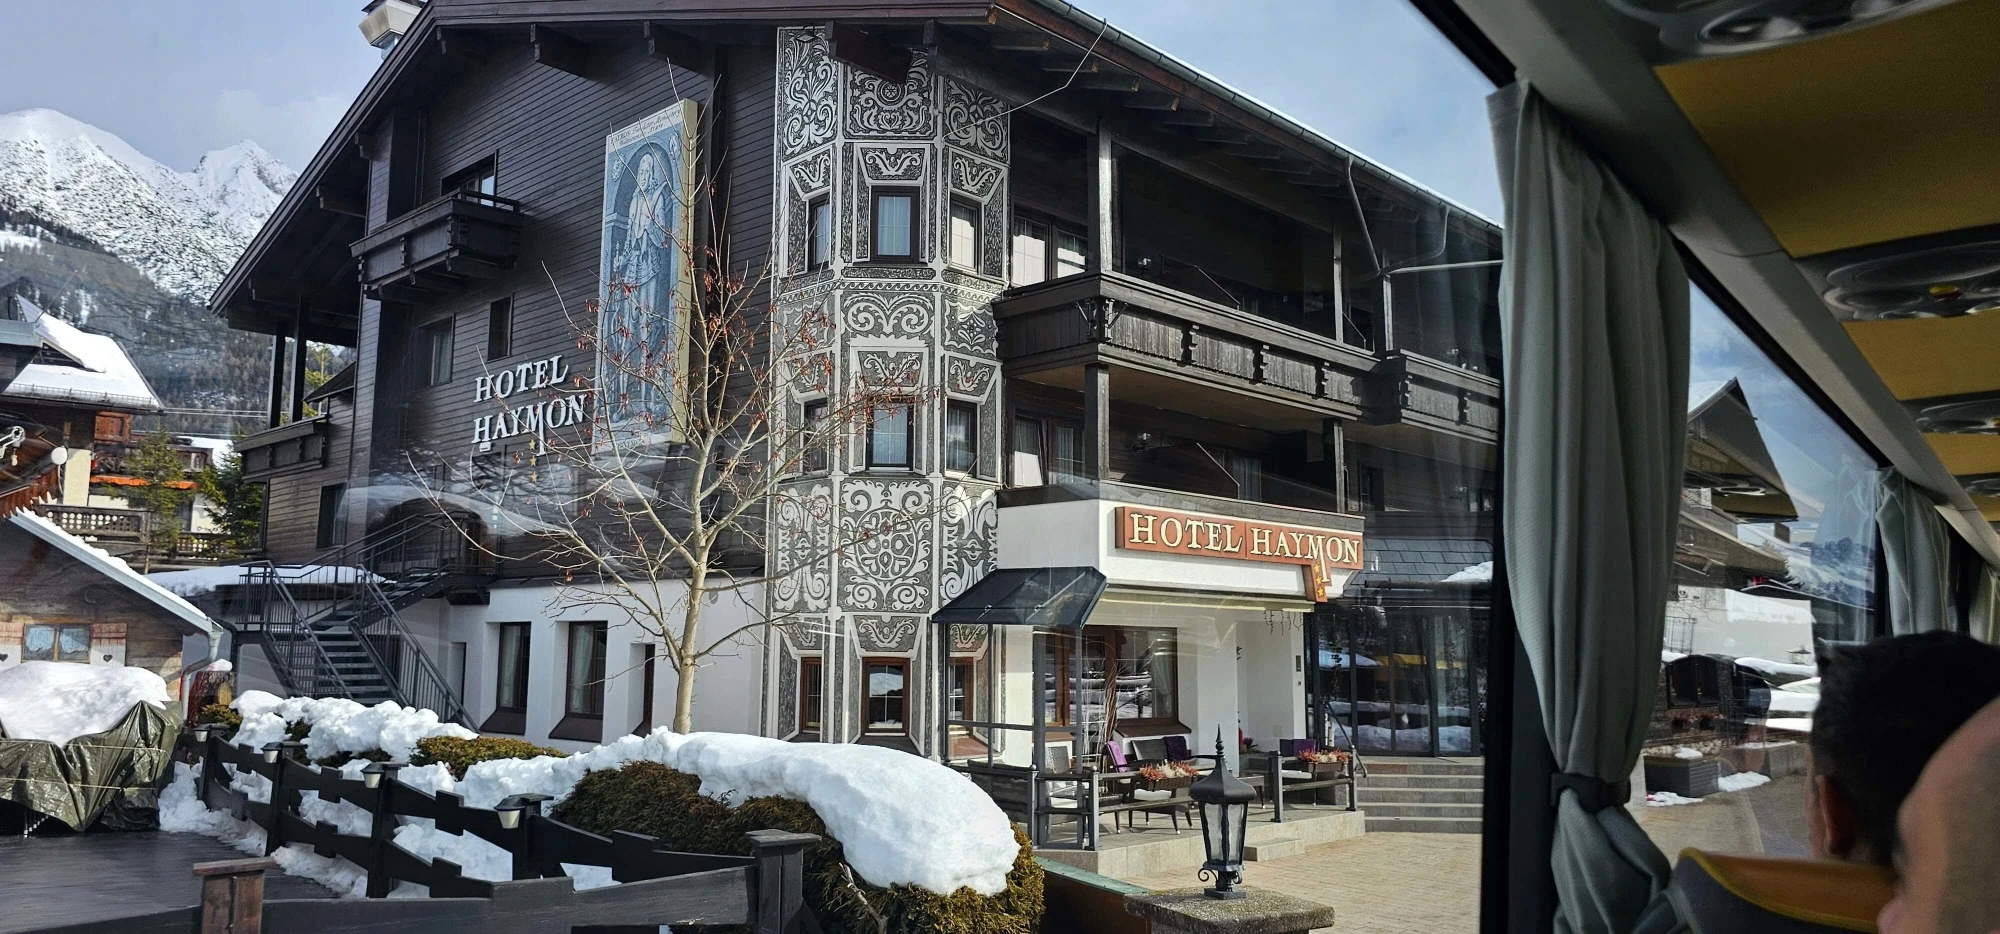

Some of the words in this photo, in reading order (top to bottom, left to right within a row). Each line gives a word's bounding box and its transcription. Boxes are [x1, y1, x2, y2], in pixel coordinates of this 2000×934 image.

[473, 355, 569, 402] HOTEL
[471, 394, 587, 456] HAYMON
[1129, 513, 1243, 553] HOTEL
[1250, 527, 1360, 583] HAYMON
